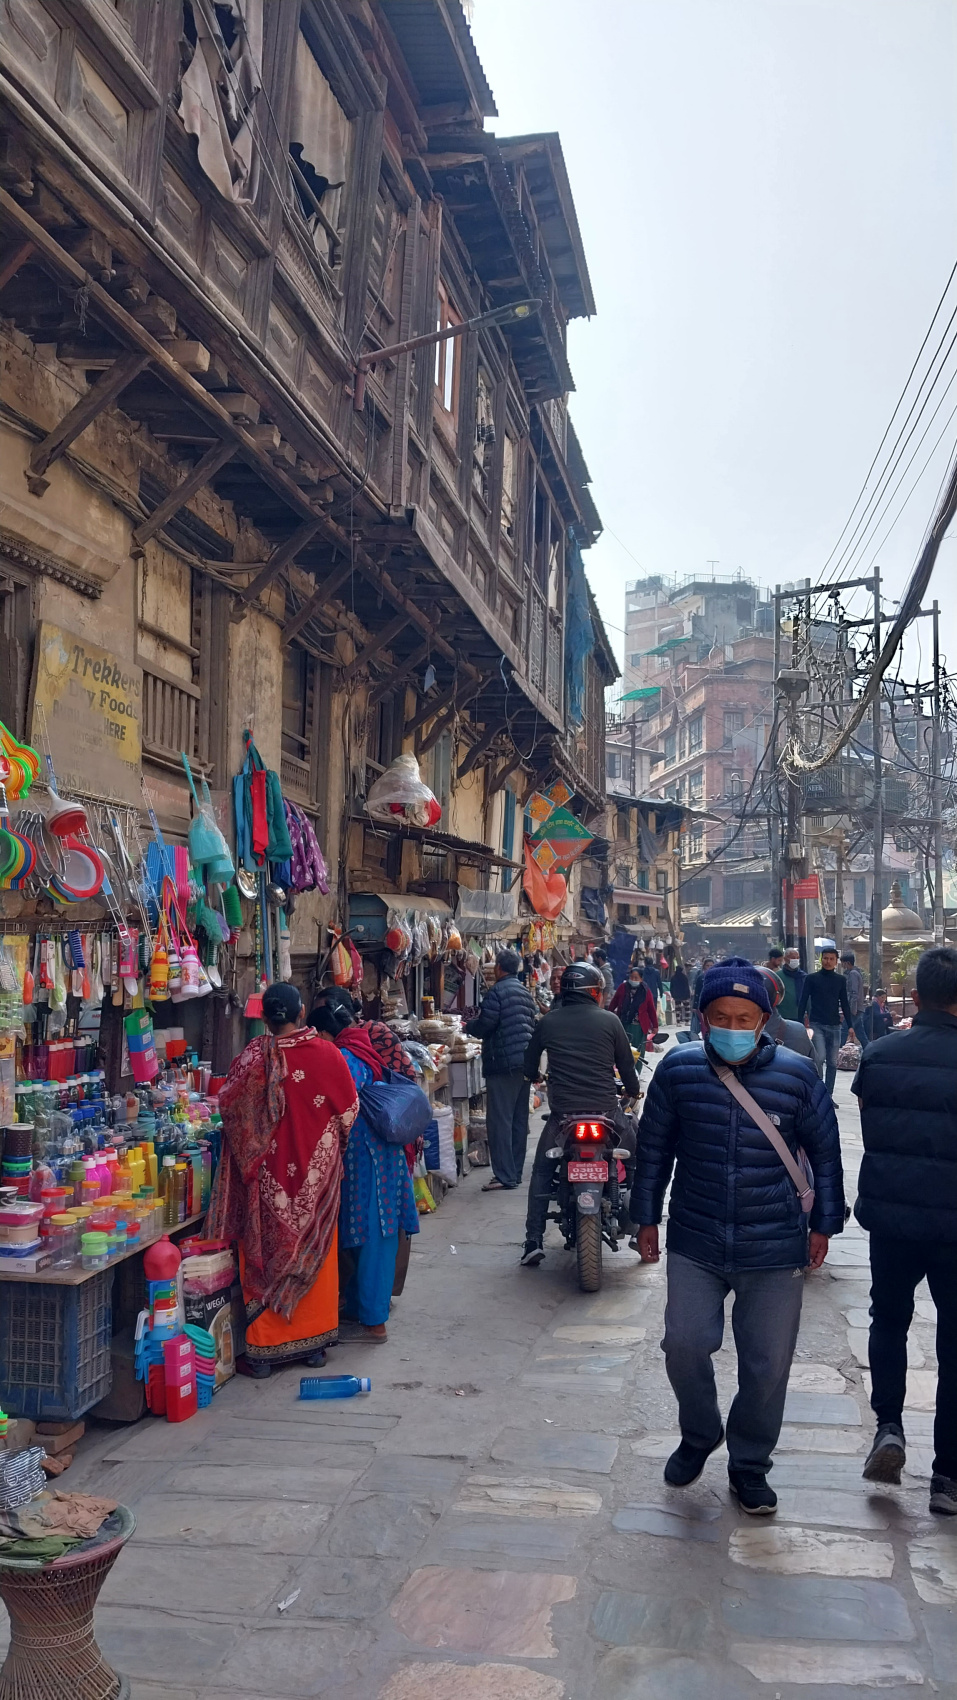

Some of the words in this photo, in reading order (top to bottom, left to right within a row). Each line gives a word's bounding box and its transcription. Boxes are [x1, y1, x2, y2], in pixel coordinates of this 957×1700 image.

[72, 645, 140, 697] Trekkers
[99, 689, 138, 720] Foods
[104, 717, 126, 741] HERE
[206, 1297, 226, 1311] WEGA
